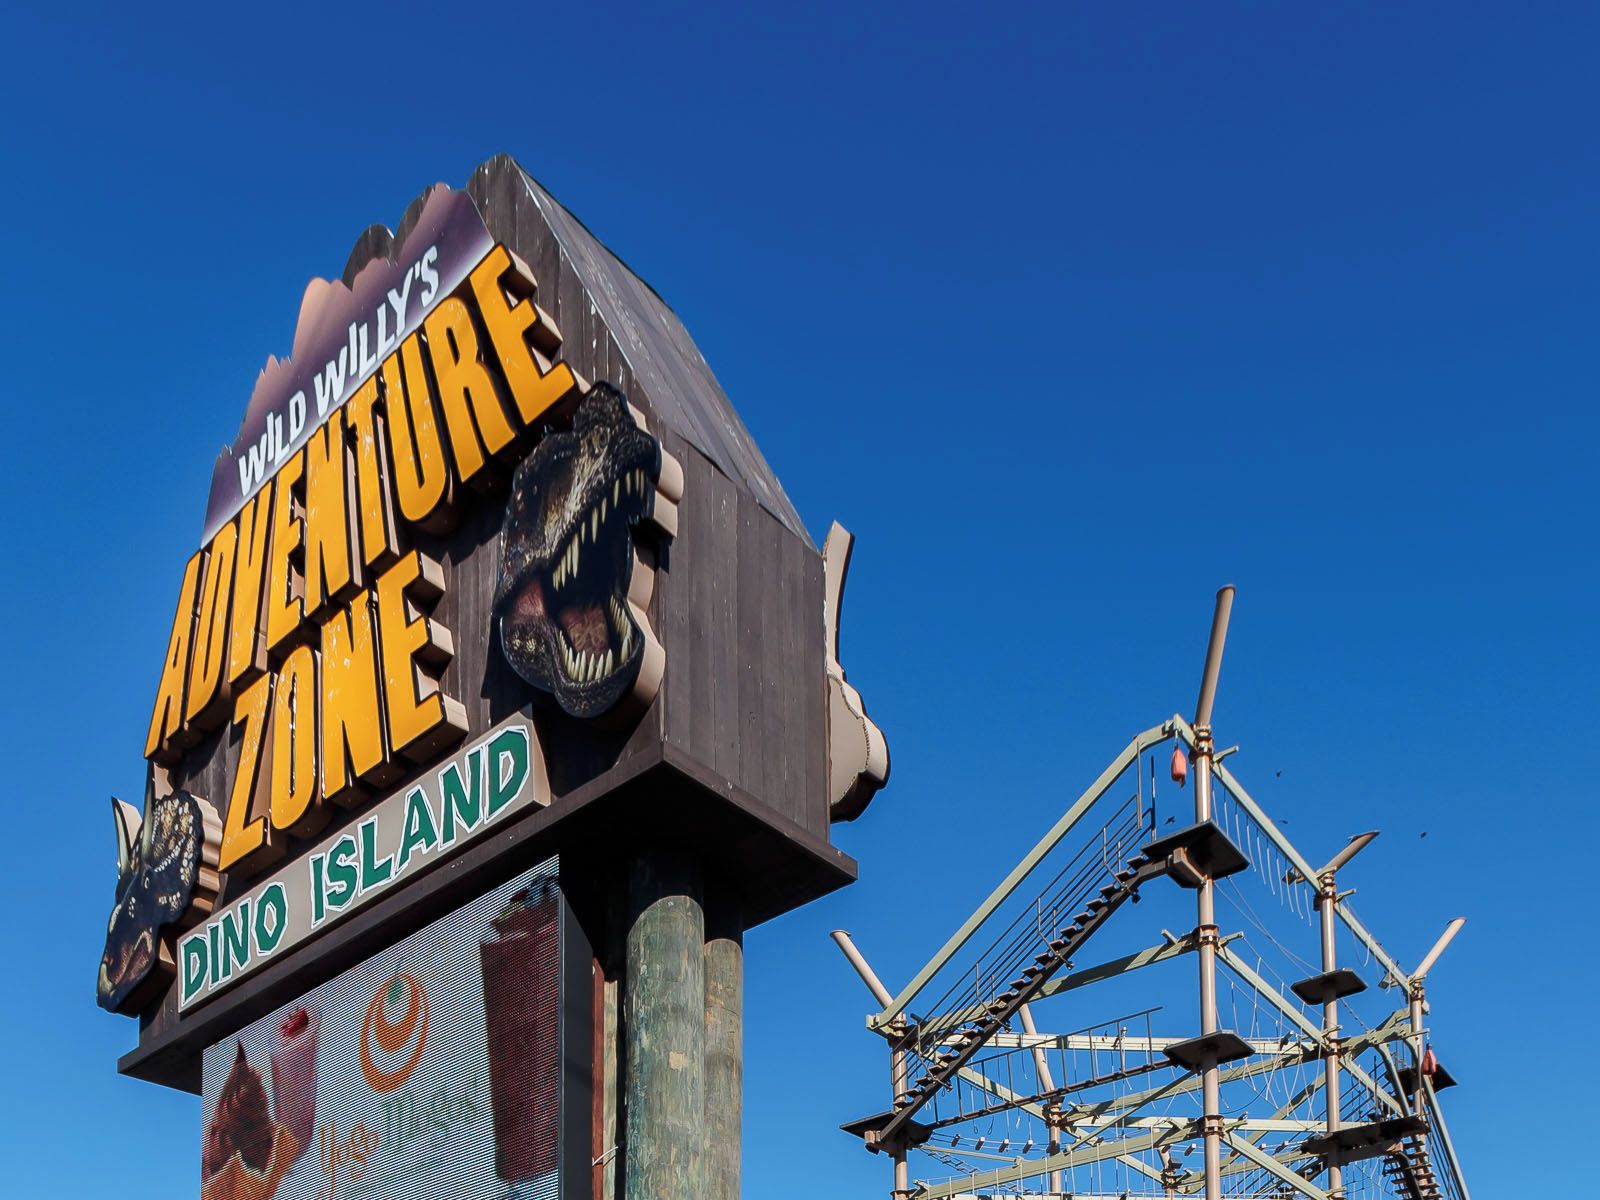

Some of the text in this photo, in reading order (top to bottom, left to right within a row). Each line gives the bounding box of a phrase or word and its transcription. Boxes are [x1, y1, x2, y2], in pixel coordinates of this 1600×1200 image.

[144, 242, 577, 759] ADVENTURE
[237, 245, 440, 498] WILD WILLY'S
[218, 548, 445, 873] ZONE
[180, 724, 531, 1006] DINO ISLAND
